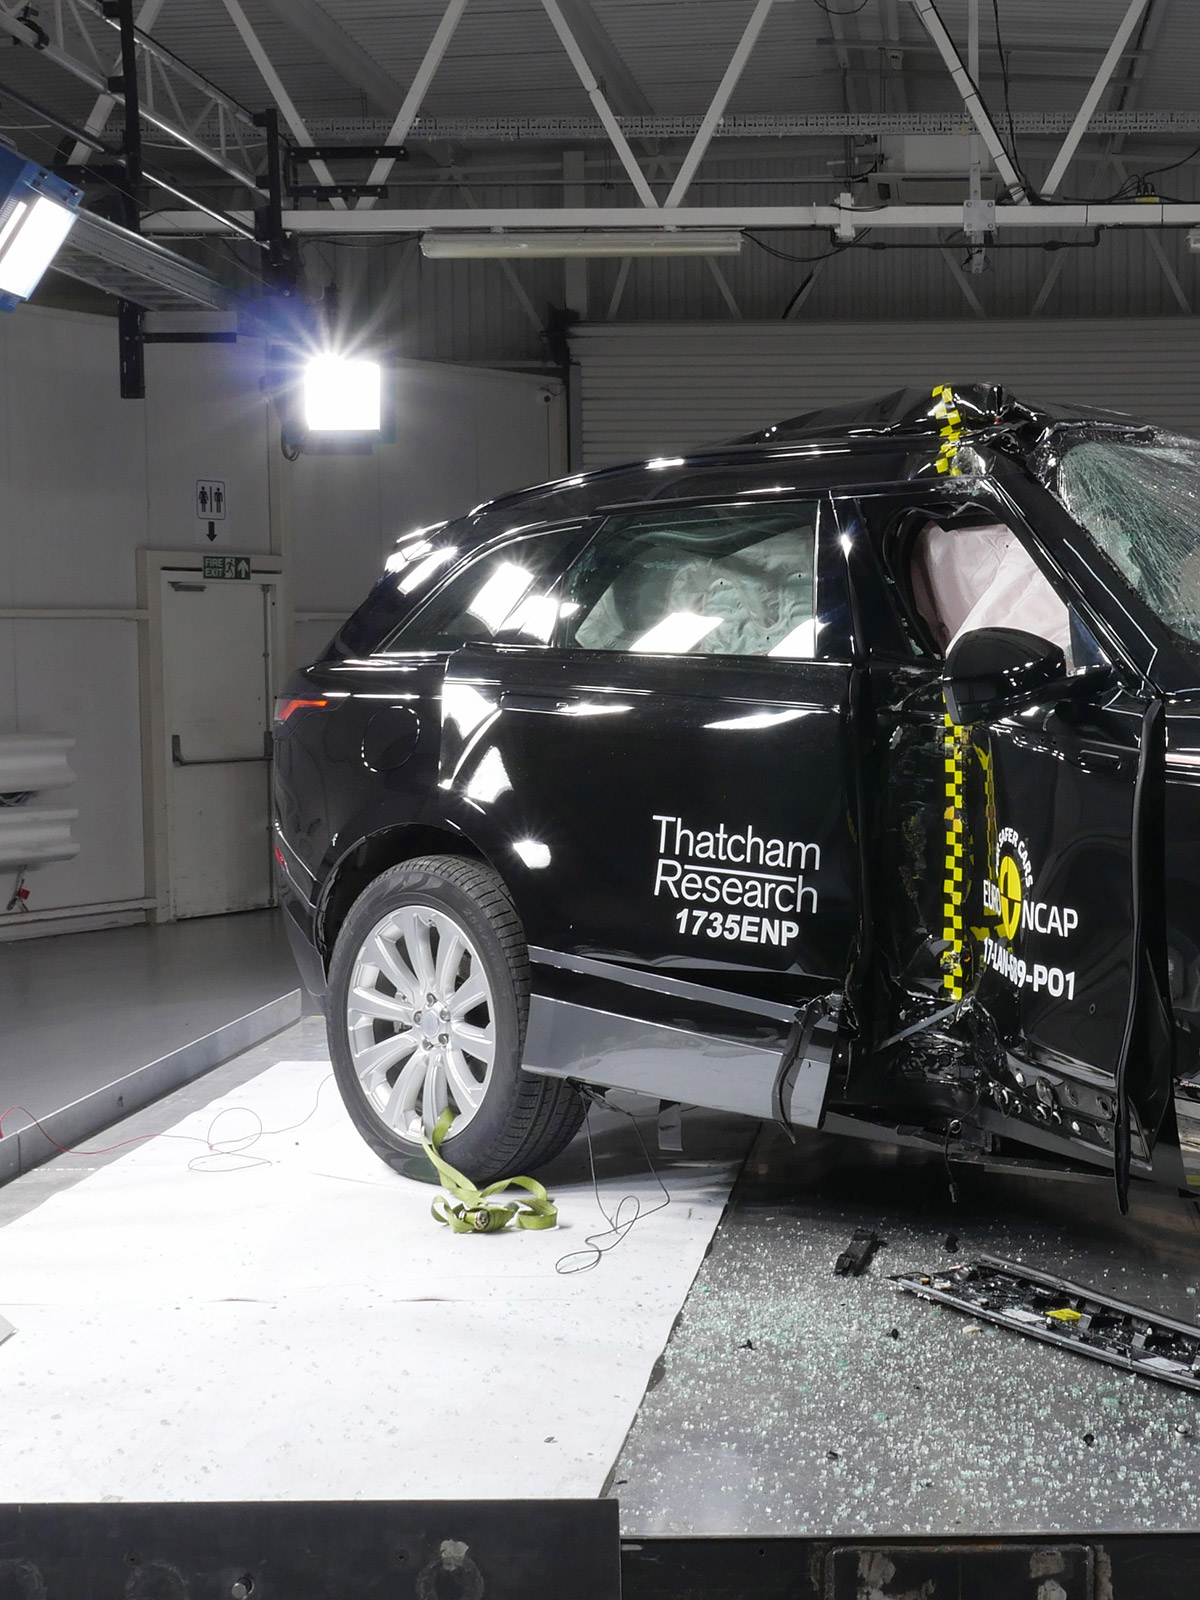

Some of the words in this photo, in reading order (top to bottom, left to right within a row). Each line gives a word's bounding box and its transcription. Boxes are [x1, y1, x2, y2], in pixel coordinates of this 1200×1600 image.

[204, 557, 224, 567] FIRE
[204, 567, 224, 577] EXIT
[652, 814, 821, 871] Thatcham
[998, 827, 1019, 848] SAFER
[1017, 840, 1034, 888] CARS
[653, 858, 818, 914] Research
[675, 907, 800, 947] 1735ENP
[1021, 899, 1079, 938] NCAP
